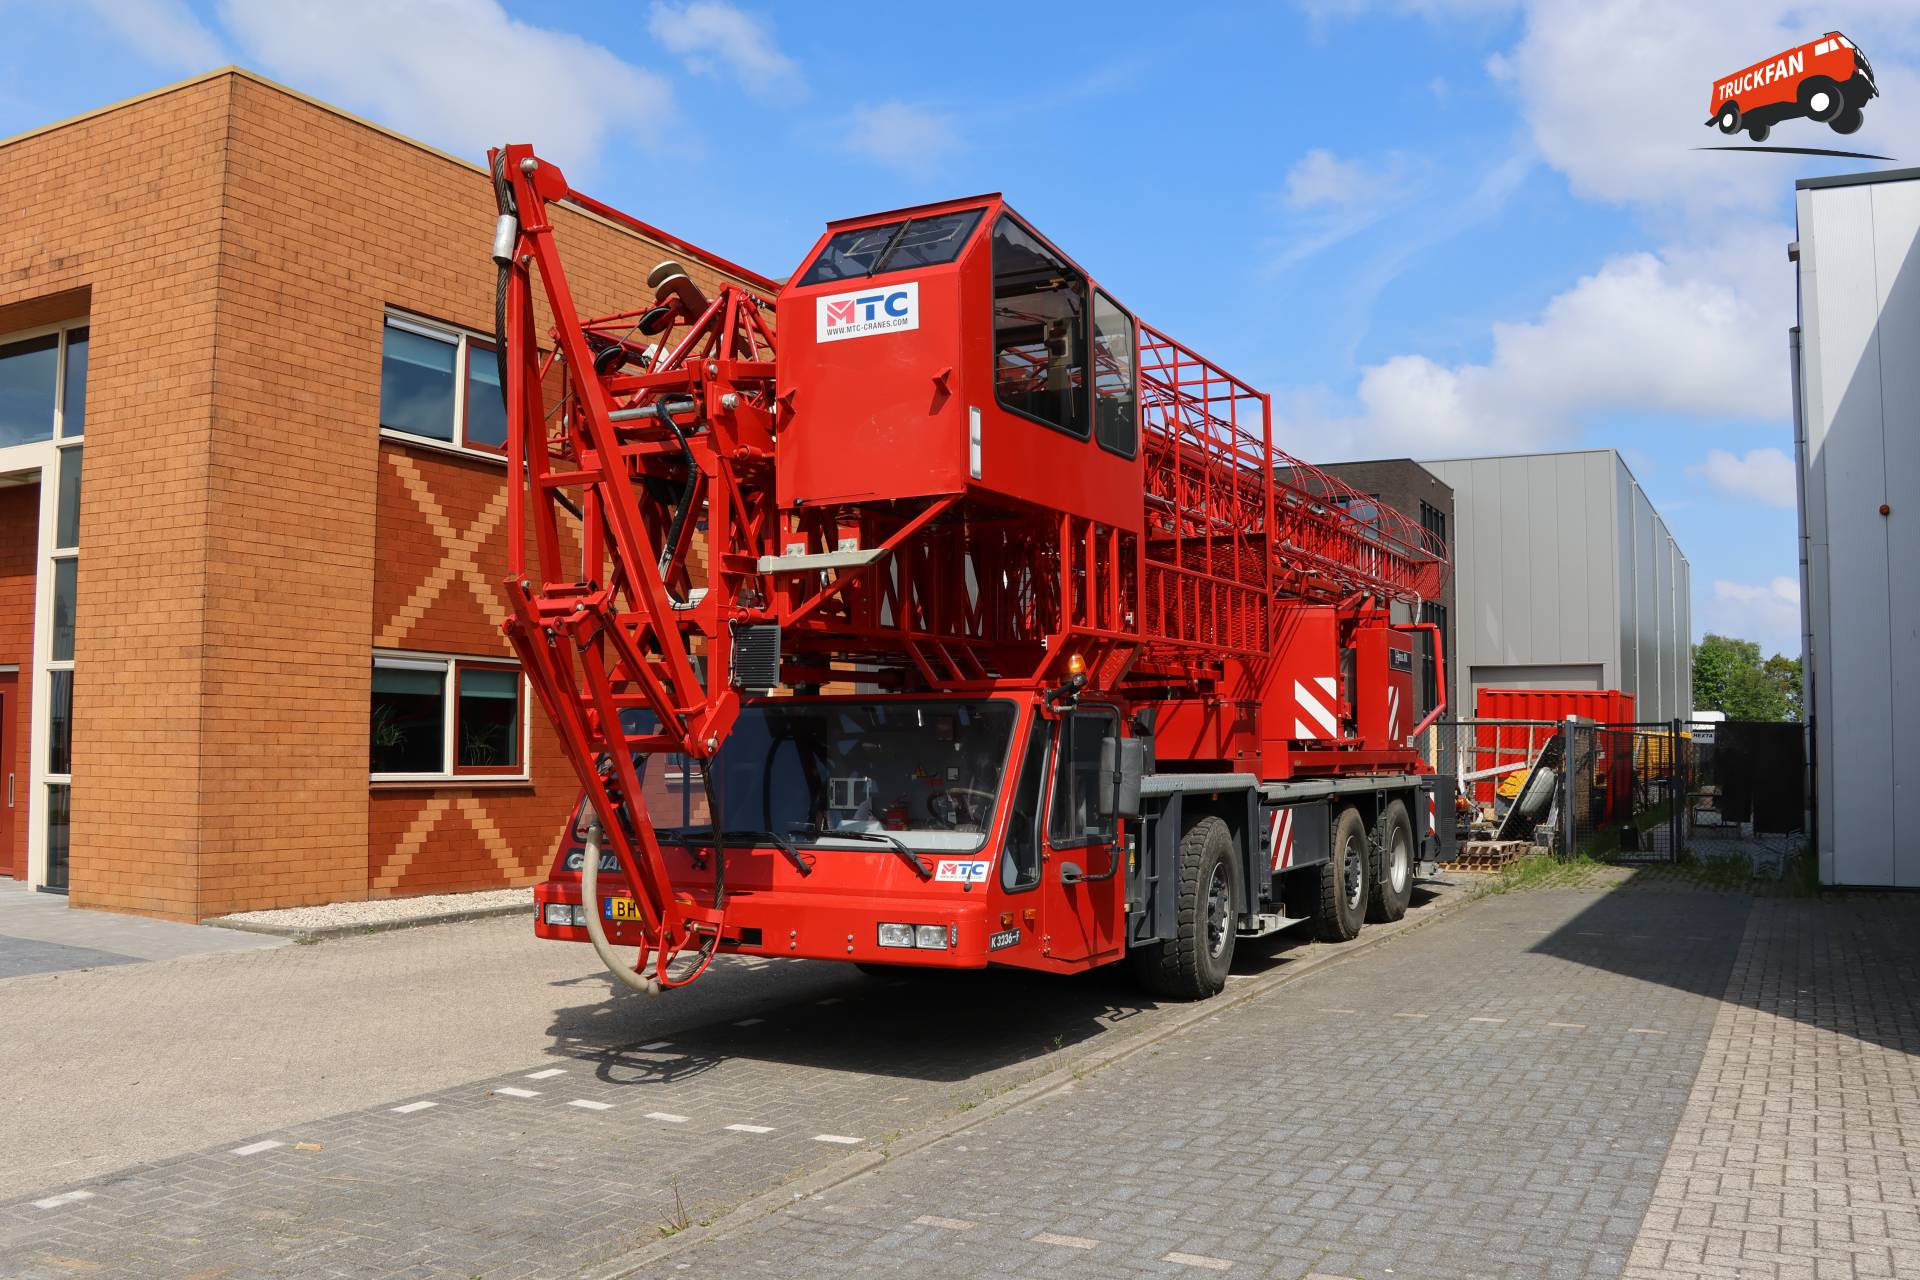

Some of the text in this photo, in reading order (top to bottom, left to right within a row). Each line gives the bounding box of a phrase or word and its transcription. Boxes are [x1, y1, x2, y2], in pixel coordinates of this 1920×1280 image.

[827, 291, 908, 327] MTC
[826, 317, 909, 337] WWW.MTC-CRANES.COM
[941, 863, 985, 875] MTC
